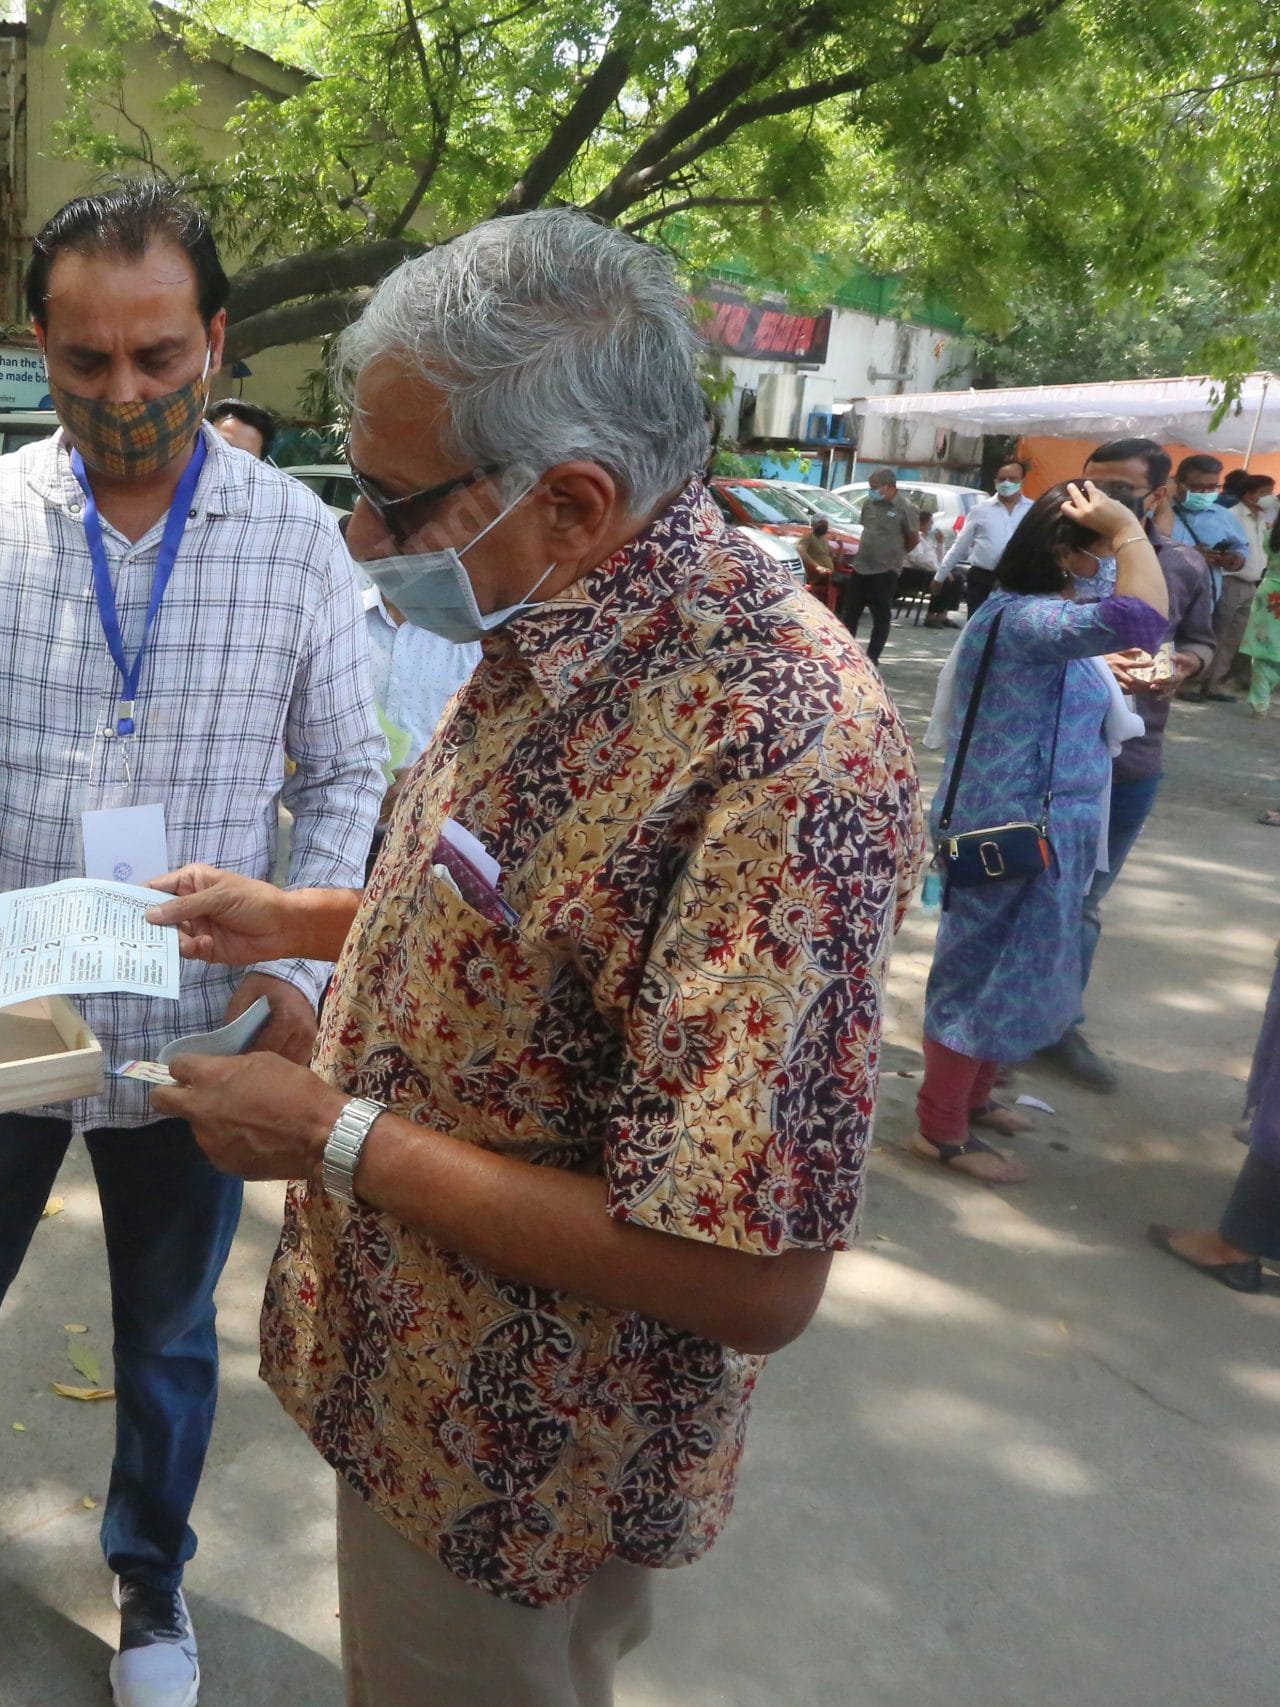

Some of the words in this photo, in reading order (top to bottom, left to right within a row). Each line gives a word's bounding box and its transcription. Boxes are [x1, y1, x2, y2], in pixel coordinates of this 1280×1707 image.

[20, 356, 37, 369] the
[6, 369, 33, 382] made
[35, 371, 49, 383] bo
[20, 945, 37, 954] 2
[44, 940, 61, 949] 2
